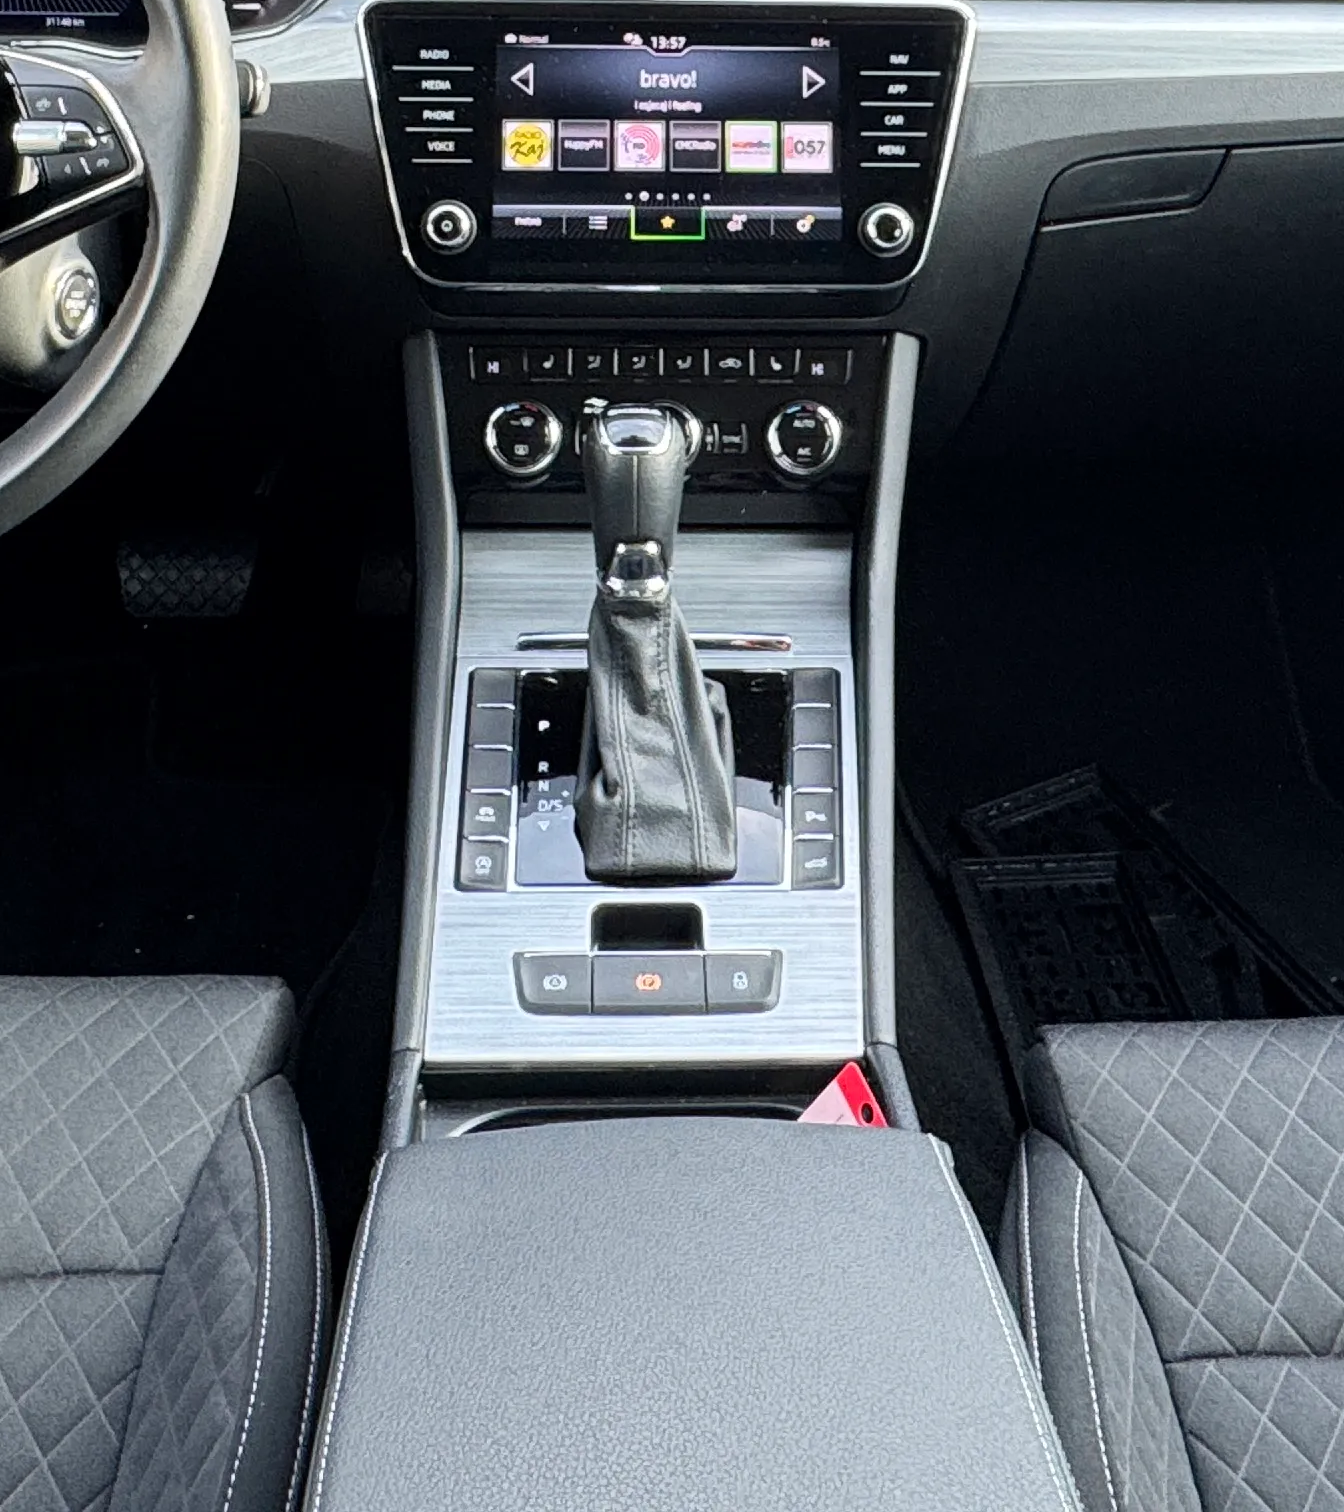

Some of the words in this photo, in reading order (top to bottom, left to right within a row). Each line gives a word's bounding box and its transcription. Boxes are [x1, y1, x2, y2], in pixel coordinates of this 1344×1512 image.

[650, 35, 687, 50] 13:57
[419, 48, 450, 60] RADIO
[888, 53, 910, 65] NAV
[420, 79, 452, 91] MEDIA
[639, 69, 698, 90] bravo!
[886, 83, 909, 95] APP
[422, 109, 456, 122] PHONE
[883, 114, 905, 126] CAR
[426, 140, 456, 152] VOICE
[793, 139, 826, 155] 057
[877, 144, 906, 156] MENU
[537, 720, 551, 732] P
[537, 760, 550, 773] R
[537, 779, 550, 793] N
[537, 799, 564, 812] D/S
